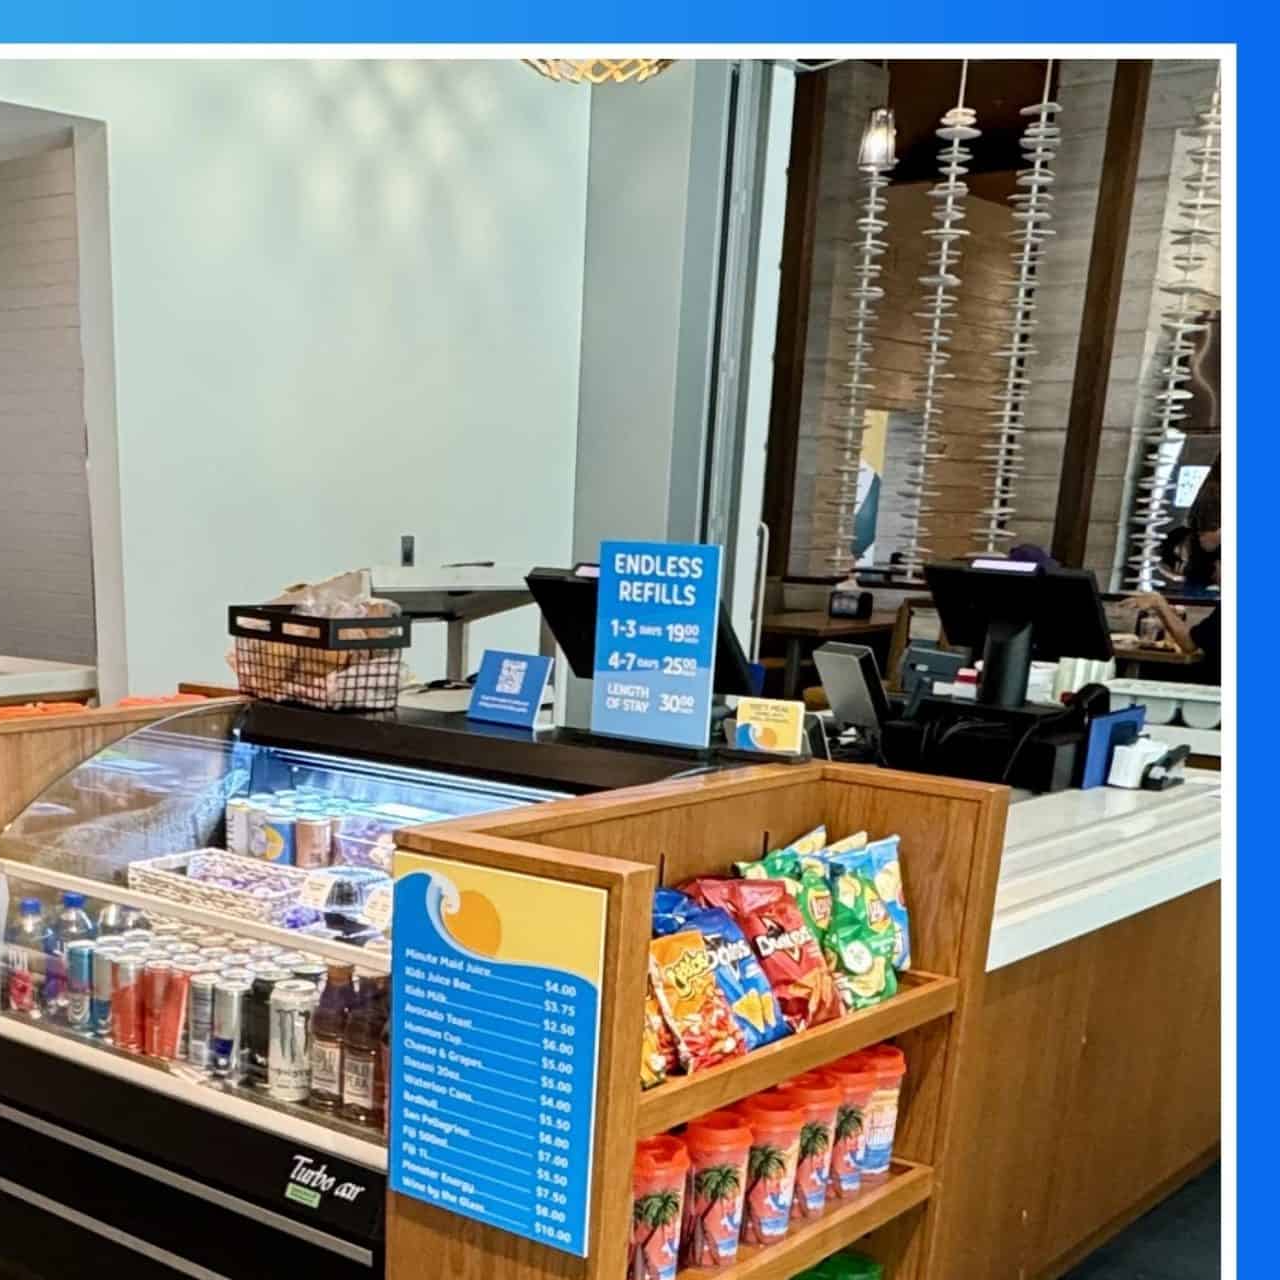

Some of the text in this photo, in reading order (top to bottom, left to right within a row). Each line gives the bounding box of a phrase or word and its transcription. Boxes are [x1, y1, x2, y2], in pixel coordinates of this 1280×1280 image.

[614, 553, 704, 579] ENDLESS
[619, 580, 697, 607] REFILLS
[610, 618, 637, 638] 1-3
[608, 650, 637, 671] 4-7
[607, 682, 650, 699] LENGTH
[606, 696, 650, 713] OF STAY
[405, 948, 576, 998] Minute Maid Juice $4.00
[427, 970, 451, 987] Juice
[544, 999, 576, 1017] $3.75
[404, 1002, 444, 1022] Avocado
[543, 1018, 575, 1036] $2.50
[444, 1031, 462, 1046] Cup
[289, 1155, 336, 1191] Turbo
[402, 1176, 427, 1192] Wine
[427, 1184, 440, 1199] by
[441, 1189, 457, 1204] the
[534, 1221, 572, 1244] $10.00
